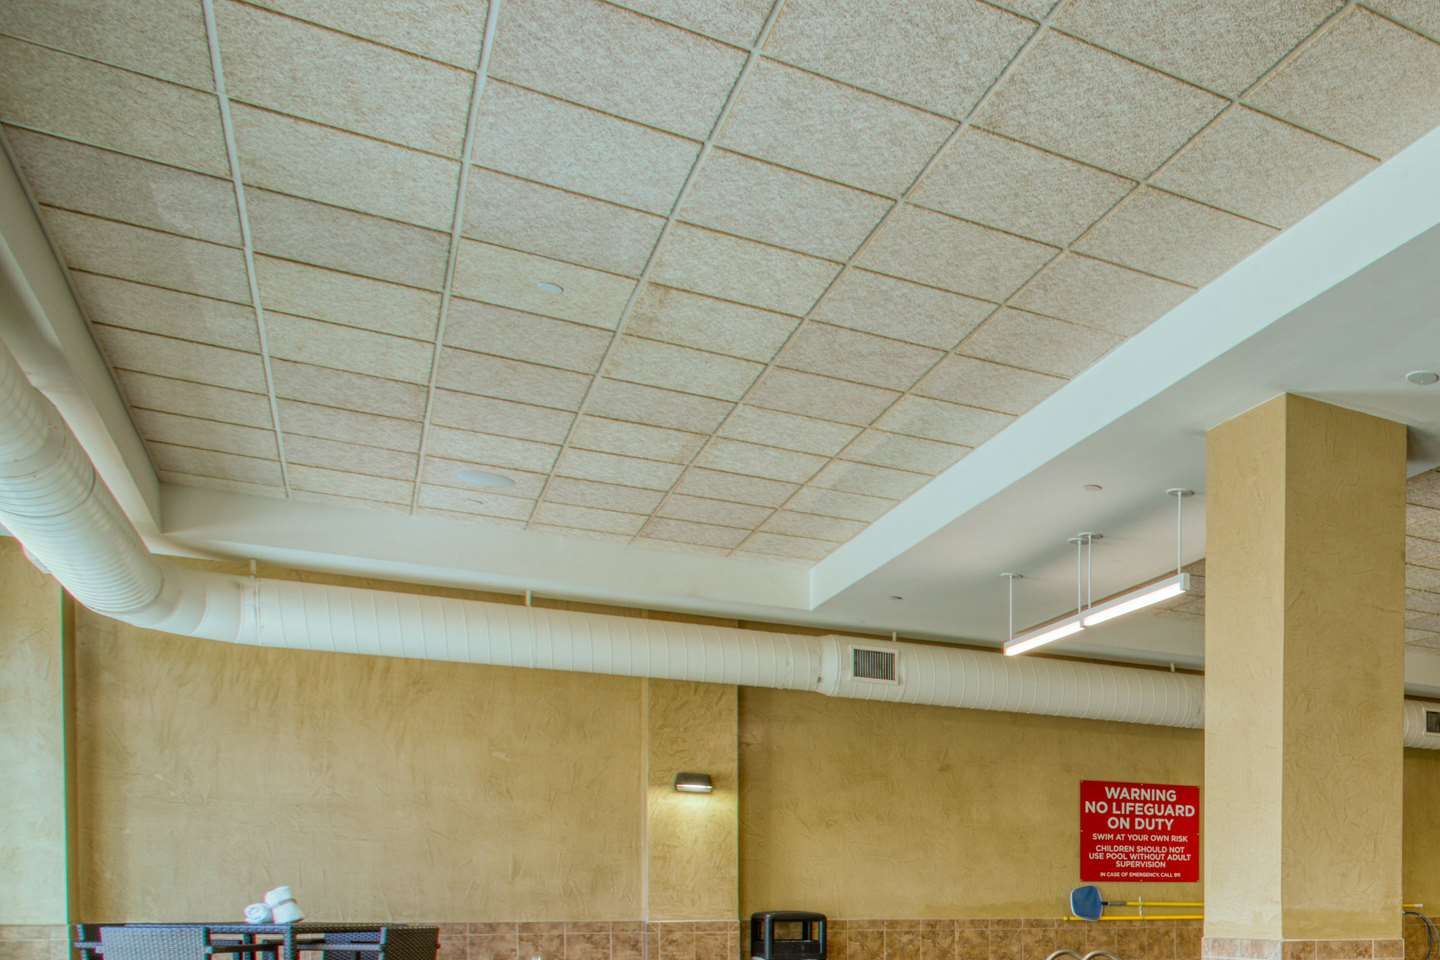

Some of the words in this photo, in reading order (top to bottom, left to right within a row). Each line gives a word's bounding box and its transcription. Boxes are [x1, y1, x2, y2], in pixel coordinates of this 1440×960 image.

[1104, 786, 1177, 801] WARNING
[1085, 801, 1108, 814] NO
[1112, 802, 1195, 817] LIFEGUARD
[1107, 816, 1130, 829] ON
[1135, 818, 1174, 830] DUTY
[1092, 833, 1114, 841] SWIM
[1127, 834, 1149, 842] YOUR
